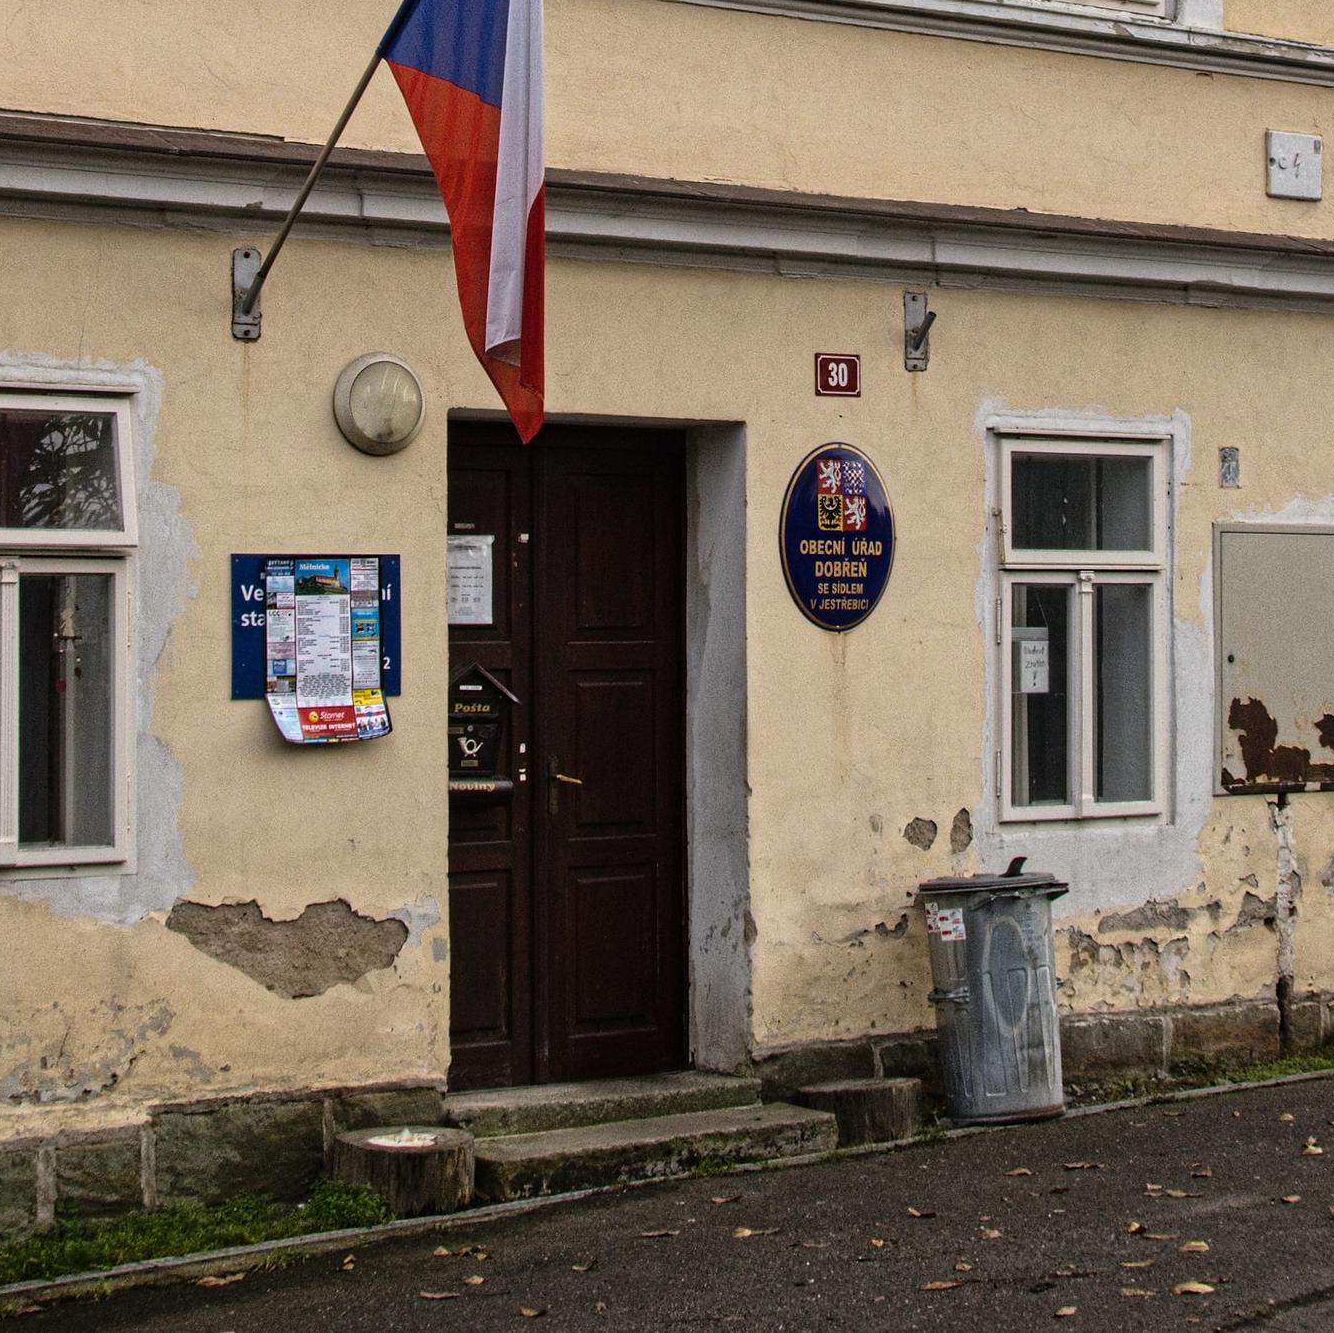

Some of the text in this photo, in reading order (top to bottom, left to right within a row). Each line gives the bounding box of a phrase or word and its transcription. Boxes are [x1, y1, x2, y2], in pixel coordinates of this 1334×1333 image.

[828, 363, 849, 387] 30
[800, 537, 883, 556] OBECNÍ ÚŘAD
[815, 558, 867, 577] DOBŘEŇ
[817, 581, 864, 594] SE SÍDLEM
[810, 599, 817, 610] V
